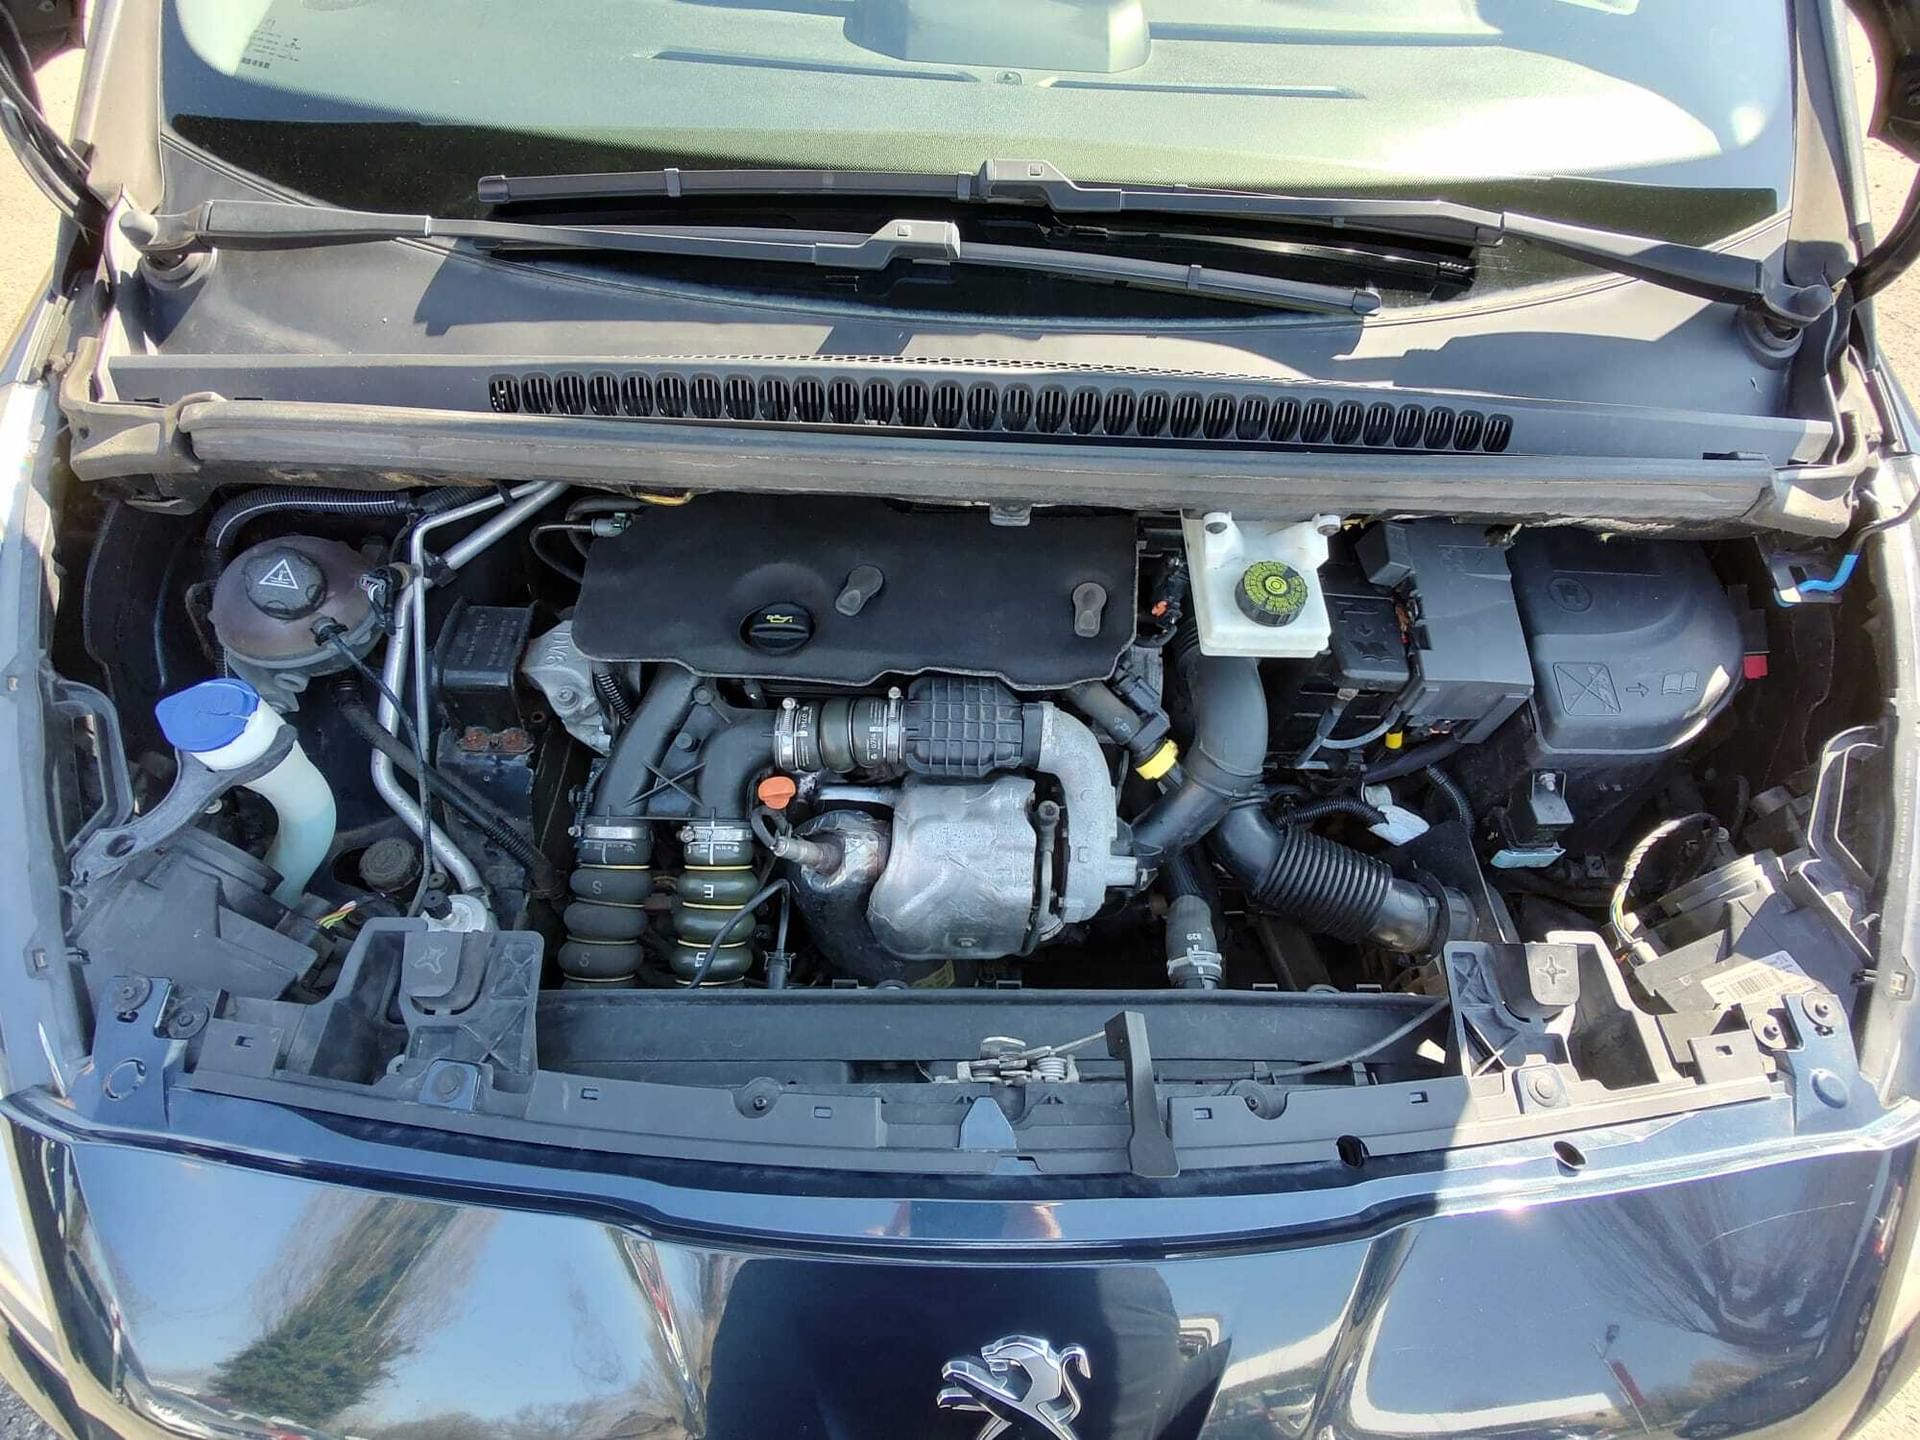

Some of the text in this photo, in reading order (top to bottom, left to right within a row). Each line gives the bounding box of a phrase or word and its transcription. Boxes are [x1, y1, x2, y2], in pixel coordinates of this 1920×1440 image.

[544, 631, 571, 665] DV6
[592, 880, 602, 894] S
[703, 884, 714, 899] E
[579, 952, 590, 967] S
